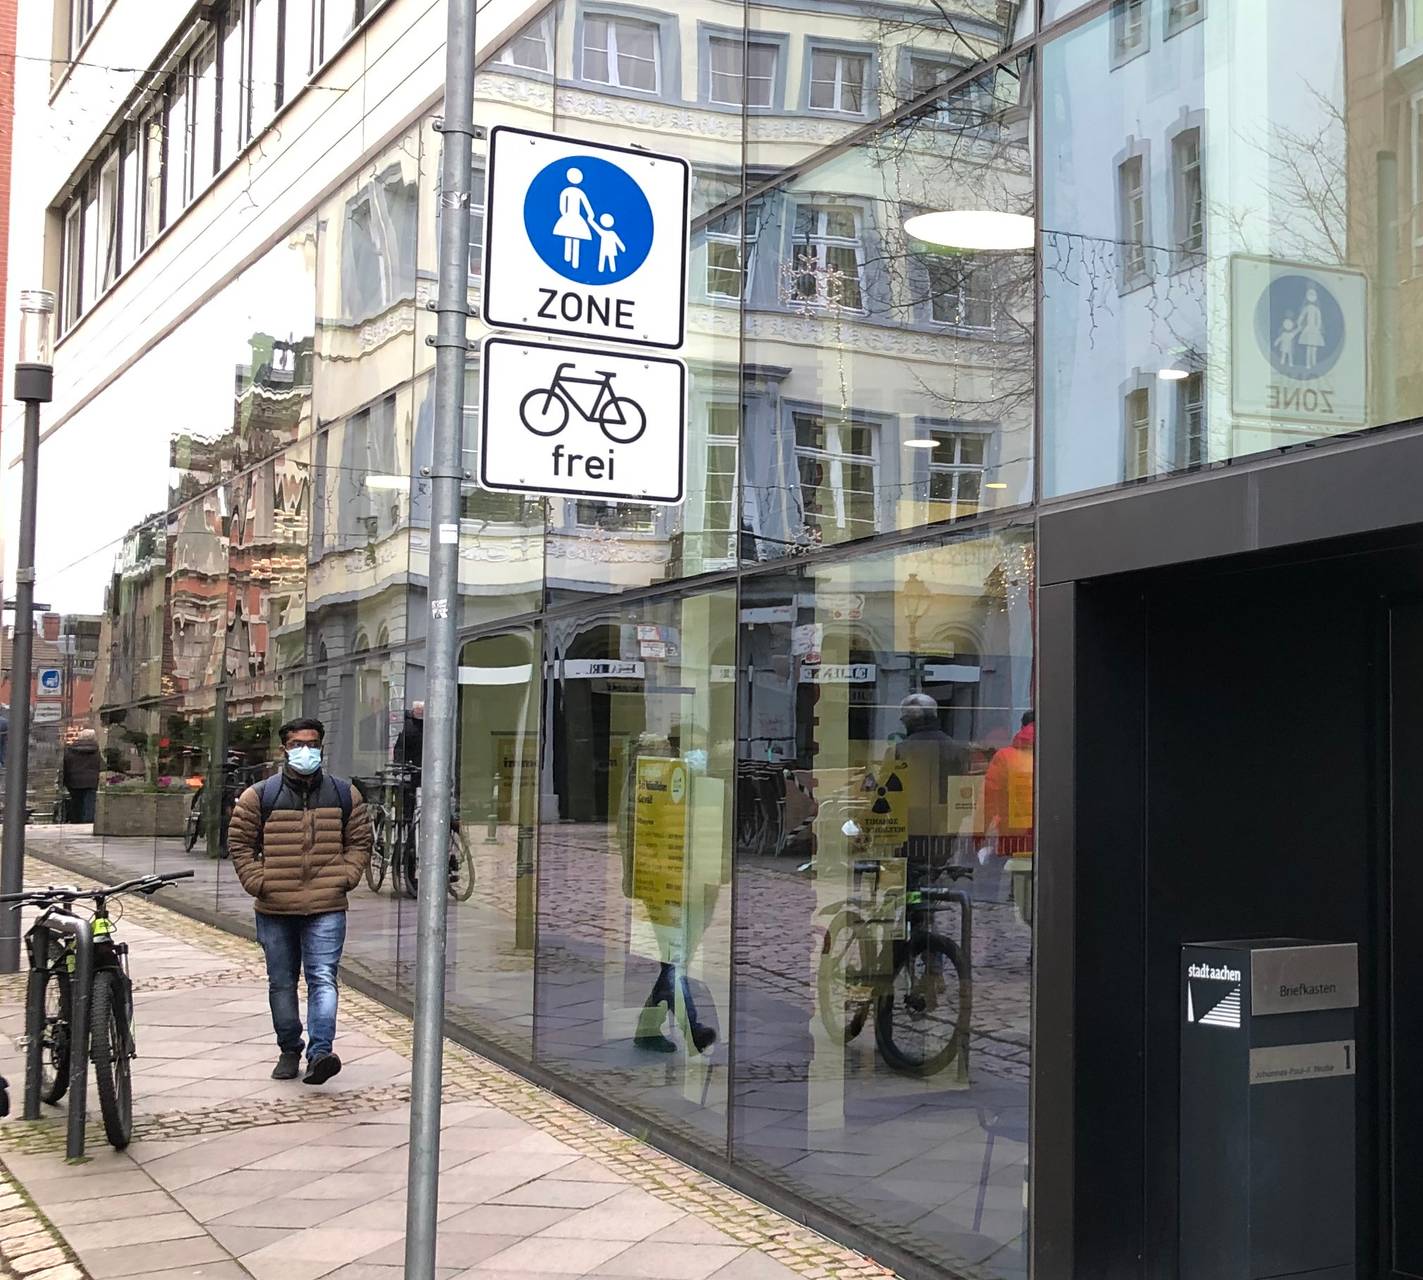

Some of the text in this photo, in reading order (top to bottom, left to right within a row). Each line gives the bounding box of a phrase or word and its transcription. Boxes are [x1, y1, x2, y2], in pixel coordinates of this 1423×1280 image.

[537, 287, 635, 330] ZONE
[551, 444, 615, 481] frei
[1188, 962, 1241, 981] stadt aachen
[1279, 983, 1337, 998] Briefkasten
[1343, 1045, 1351, 1070] 1
